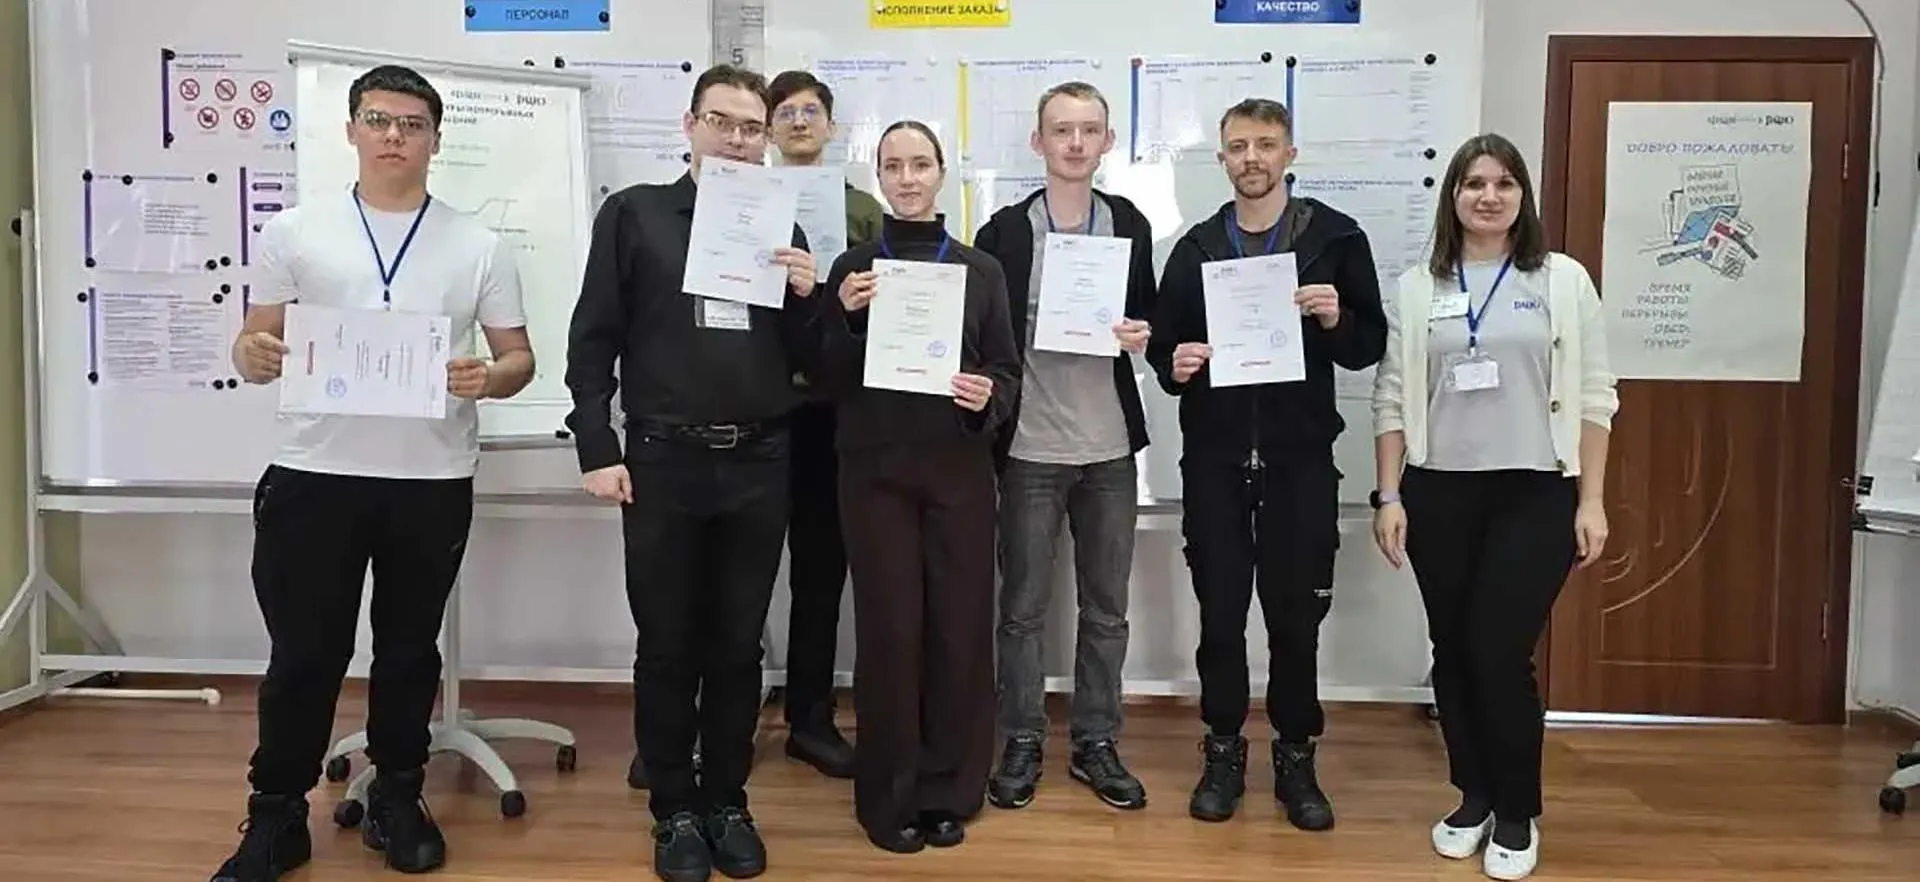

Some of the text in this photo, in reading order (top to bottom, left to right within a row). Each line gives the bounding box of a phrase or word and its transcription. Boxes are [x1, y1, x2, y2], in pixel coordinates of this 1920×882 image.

[1256, 1, 1320, 13] КАЧЕСТВО
[505, 9, 569, 20] ПЕРСОНАЛ
[731, 47, 744, 65] 5
